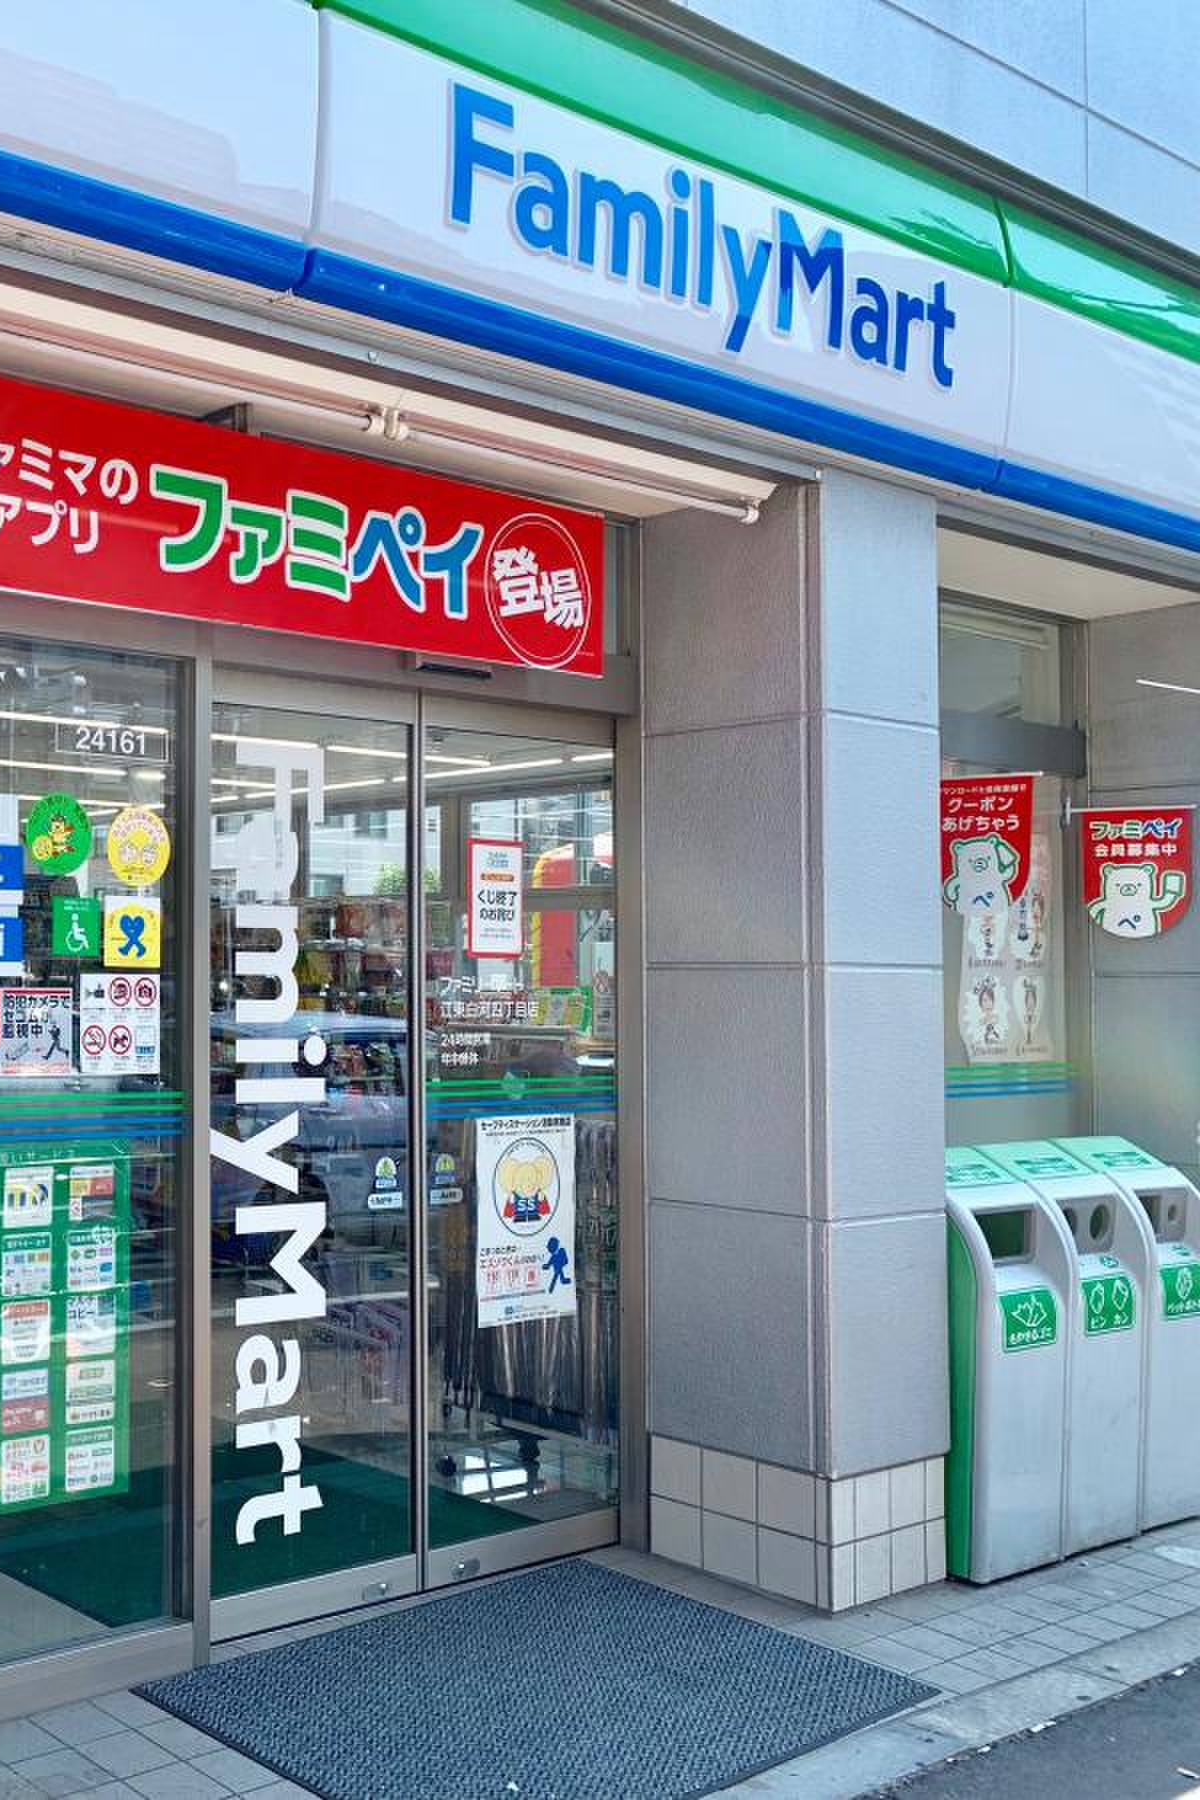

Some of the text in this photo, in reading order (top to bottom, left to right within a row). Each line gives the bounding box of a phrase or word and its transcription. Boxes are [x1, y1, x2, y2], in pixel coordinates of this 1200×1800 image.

[449, 80, 956, 388] FamilyMart
[150, 463, 484, 620] ファミペイ
[492, 545, 585, 631] 登場
[75, 727, 145, 756] 24161
[947, 796, 1013, 813] クーポン
[942, 814, 1019, 832] あげちゃう
[1089, 817, 1183, 841] ファミペイ
[1094, 843, 1178, 858] 会員募集中
[477, 889, 518, 907] くじ終了
[3, 993, 71, 1009] 防犯カメラで
[2, 1023, 44, 1039] 監視中
[210, 746, 327, 1545] FamilyMart
